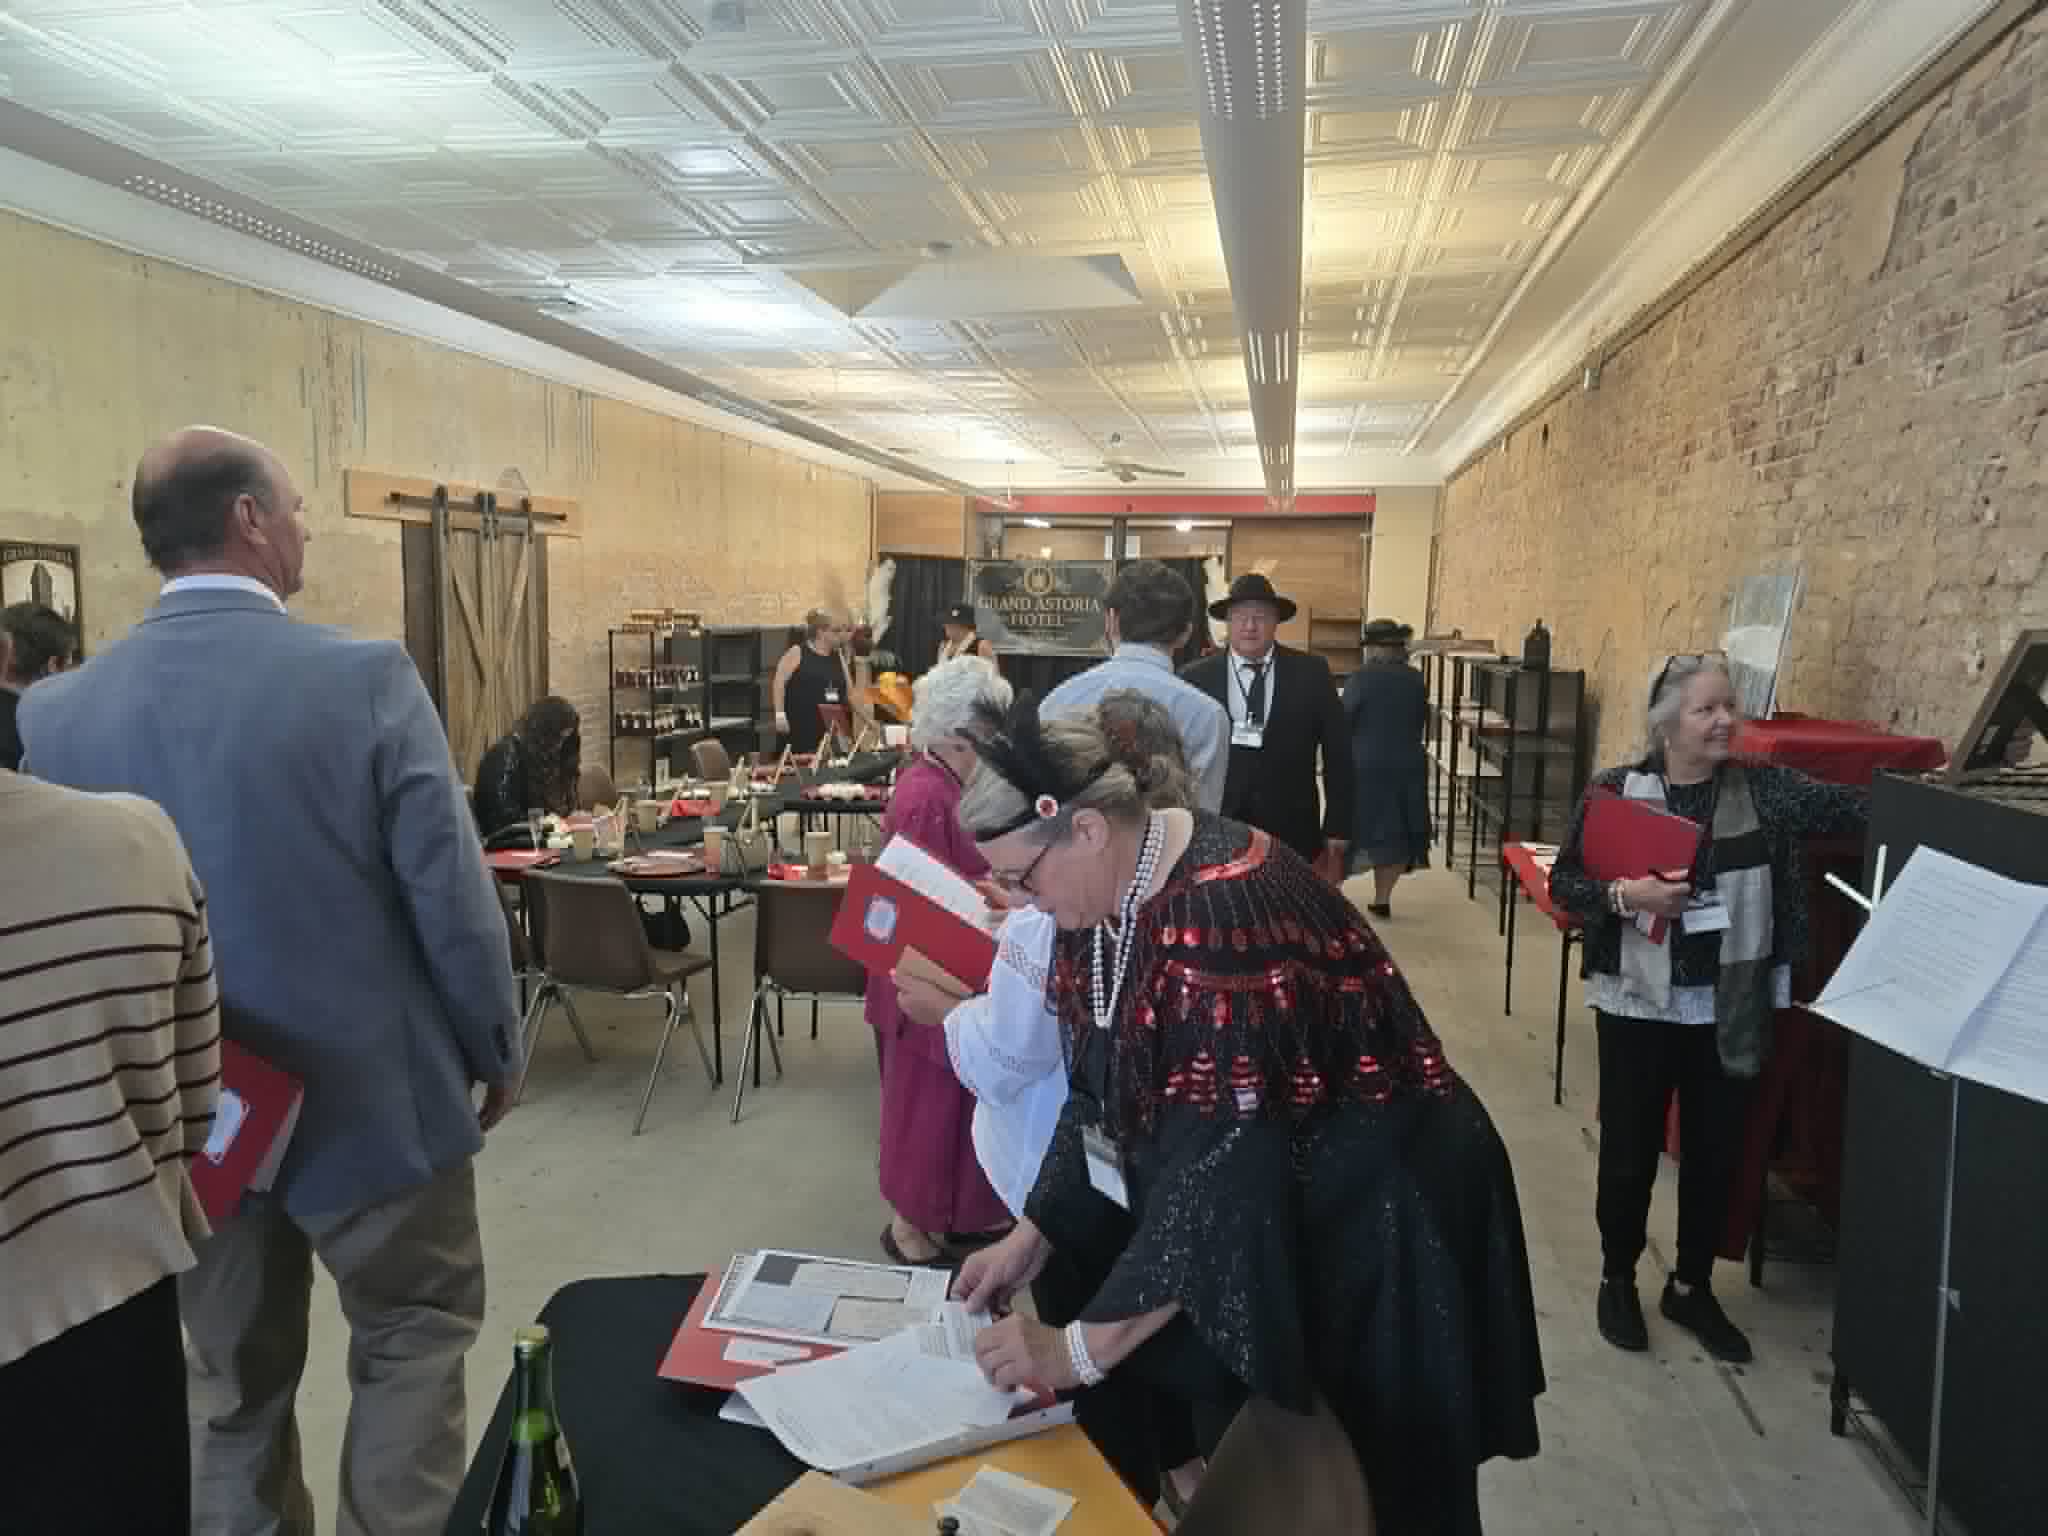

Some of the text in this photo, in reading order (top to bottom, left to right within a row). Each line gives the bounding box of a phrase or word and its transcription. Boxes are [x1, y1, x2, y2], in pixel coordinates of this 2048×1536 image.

[977, 596, 1101, 612] GRAND ASTORIA
[1009, 613, 1064, 626] HOTEL
